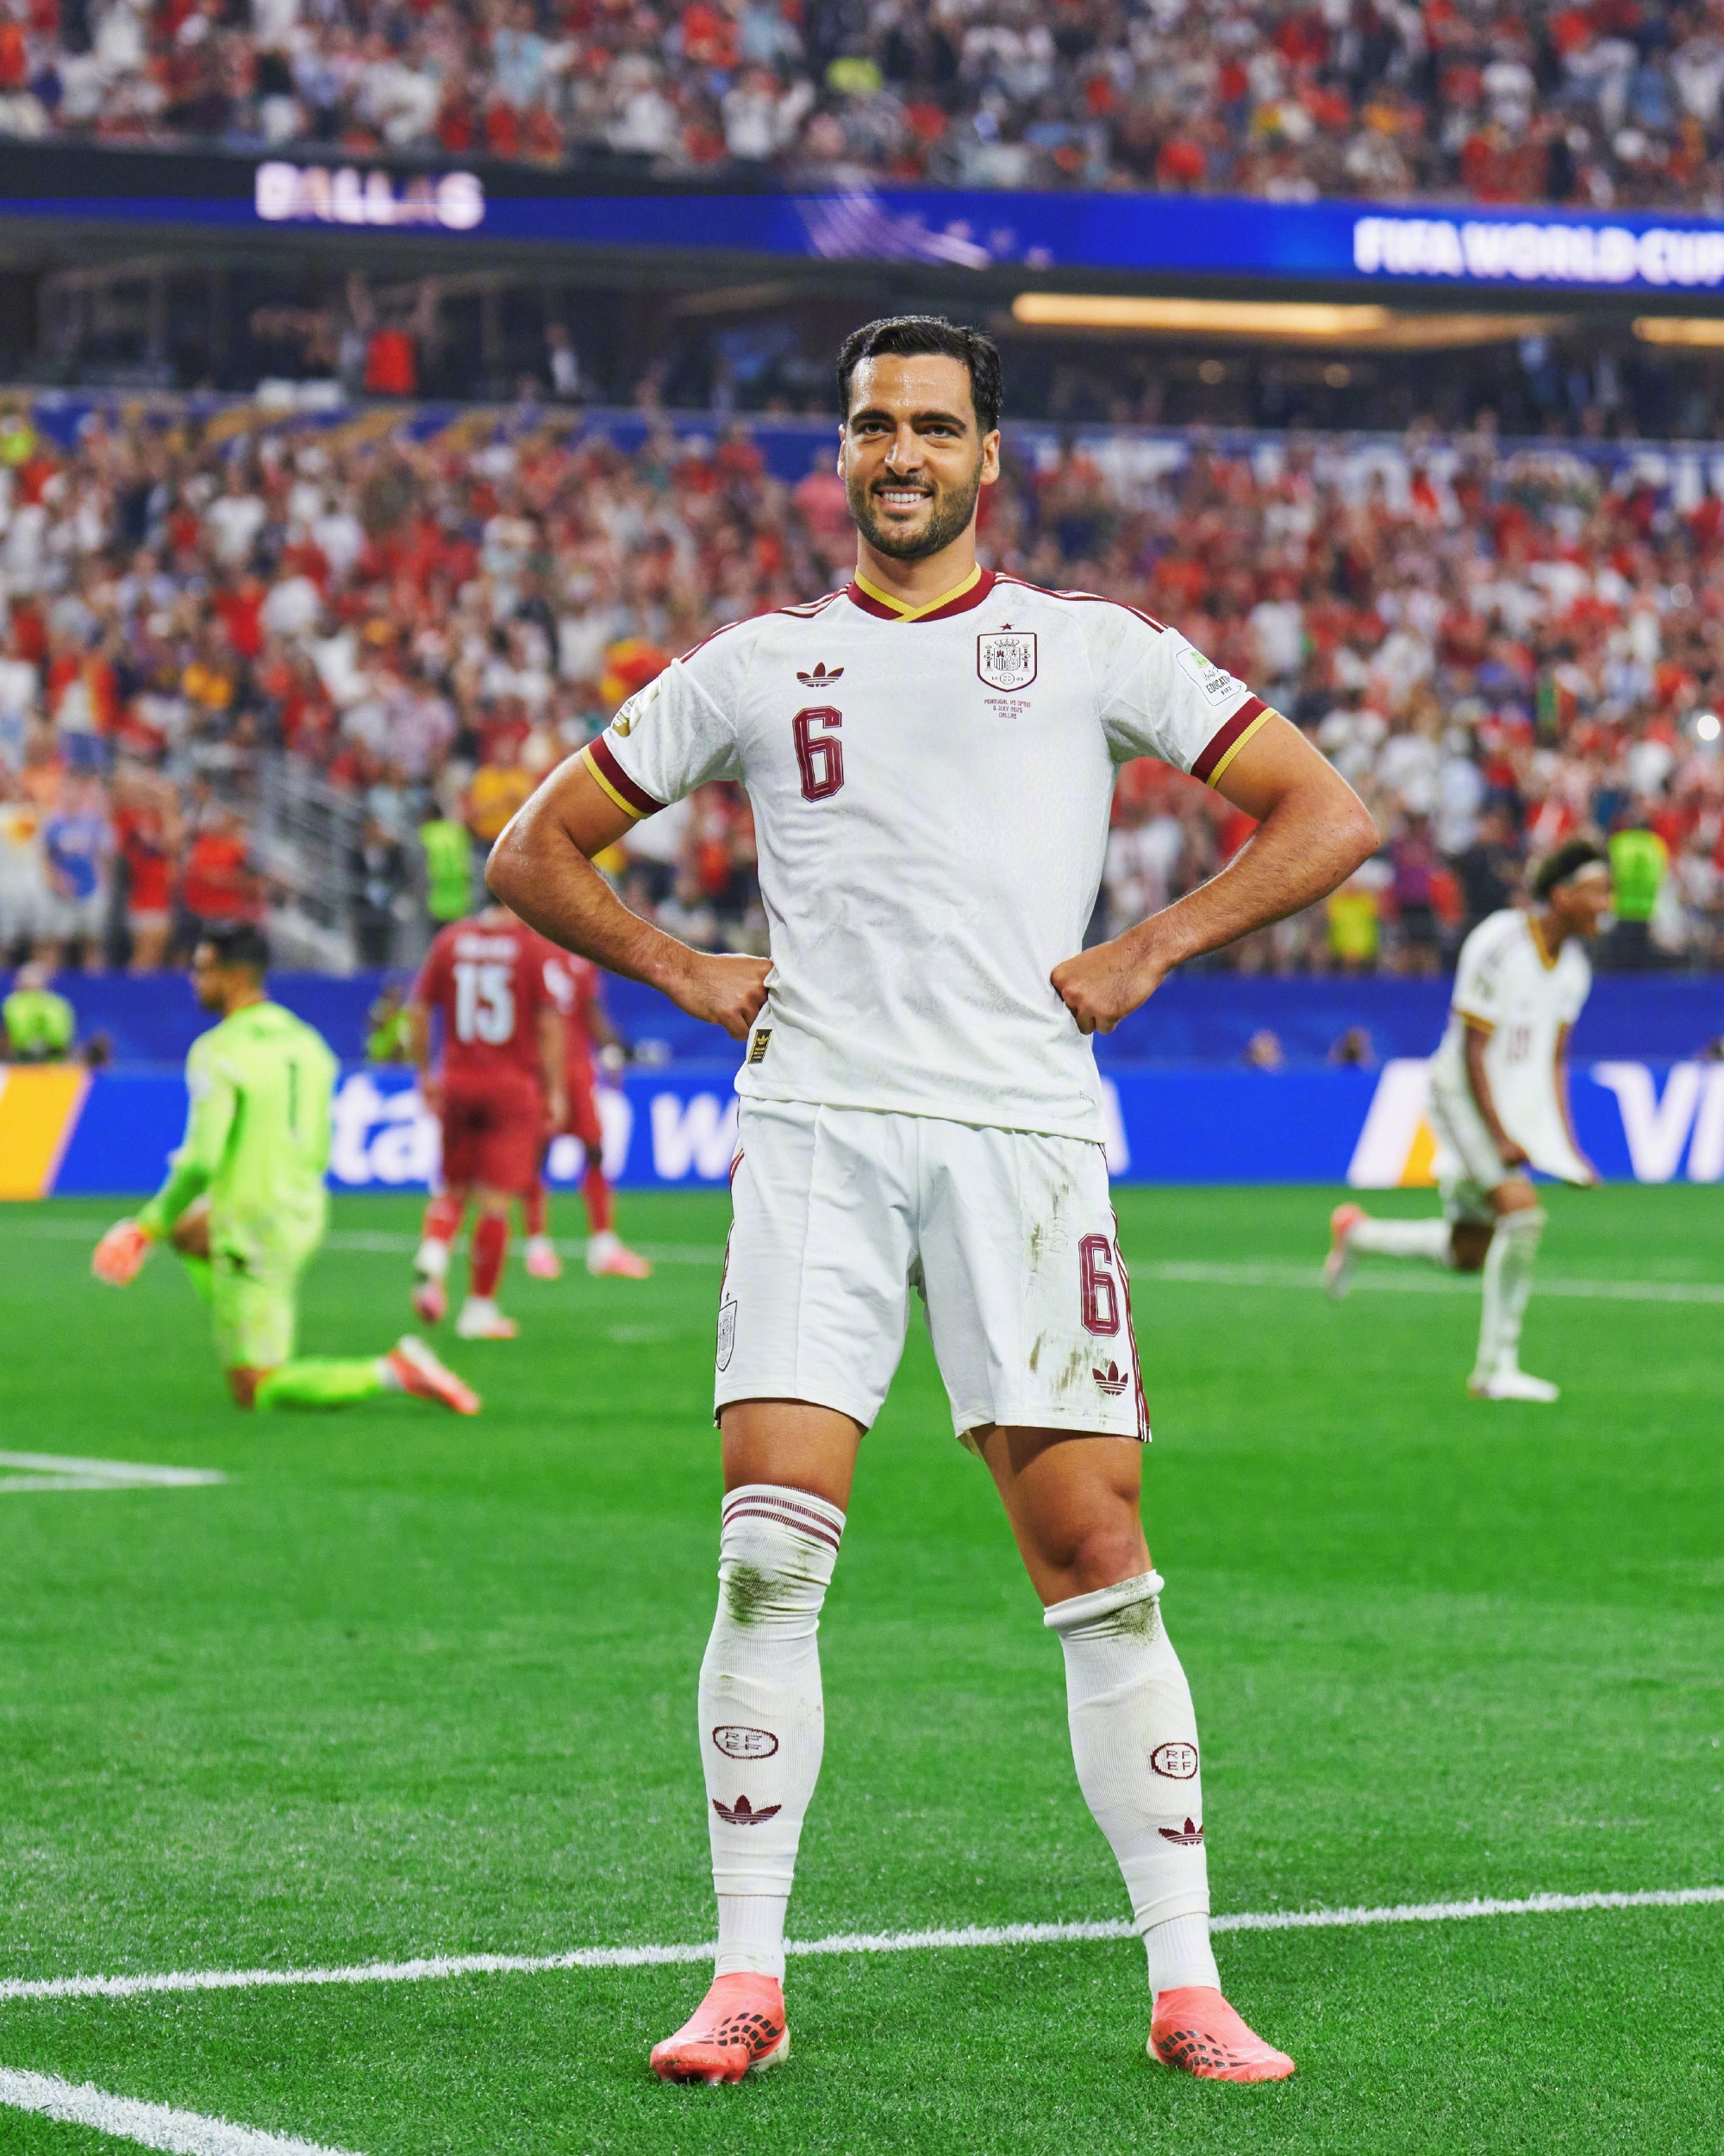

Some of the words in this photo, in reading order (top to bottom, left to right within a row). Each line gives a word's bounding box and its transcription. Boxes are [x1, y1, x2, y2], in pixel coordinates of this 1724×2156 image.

[1463, 222, 1637, 283] WORLD
[792, 705, 844, 803] 6
[452, 962, 515, 1045] 15
[1078, 1233, 1121, 1337] 6
